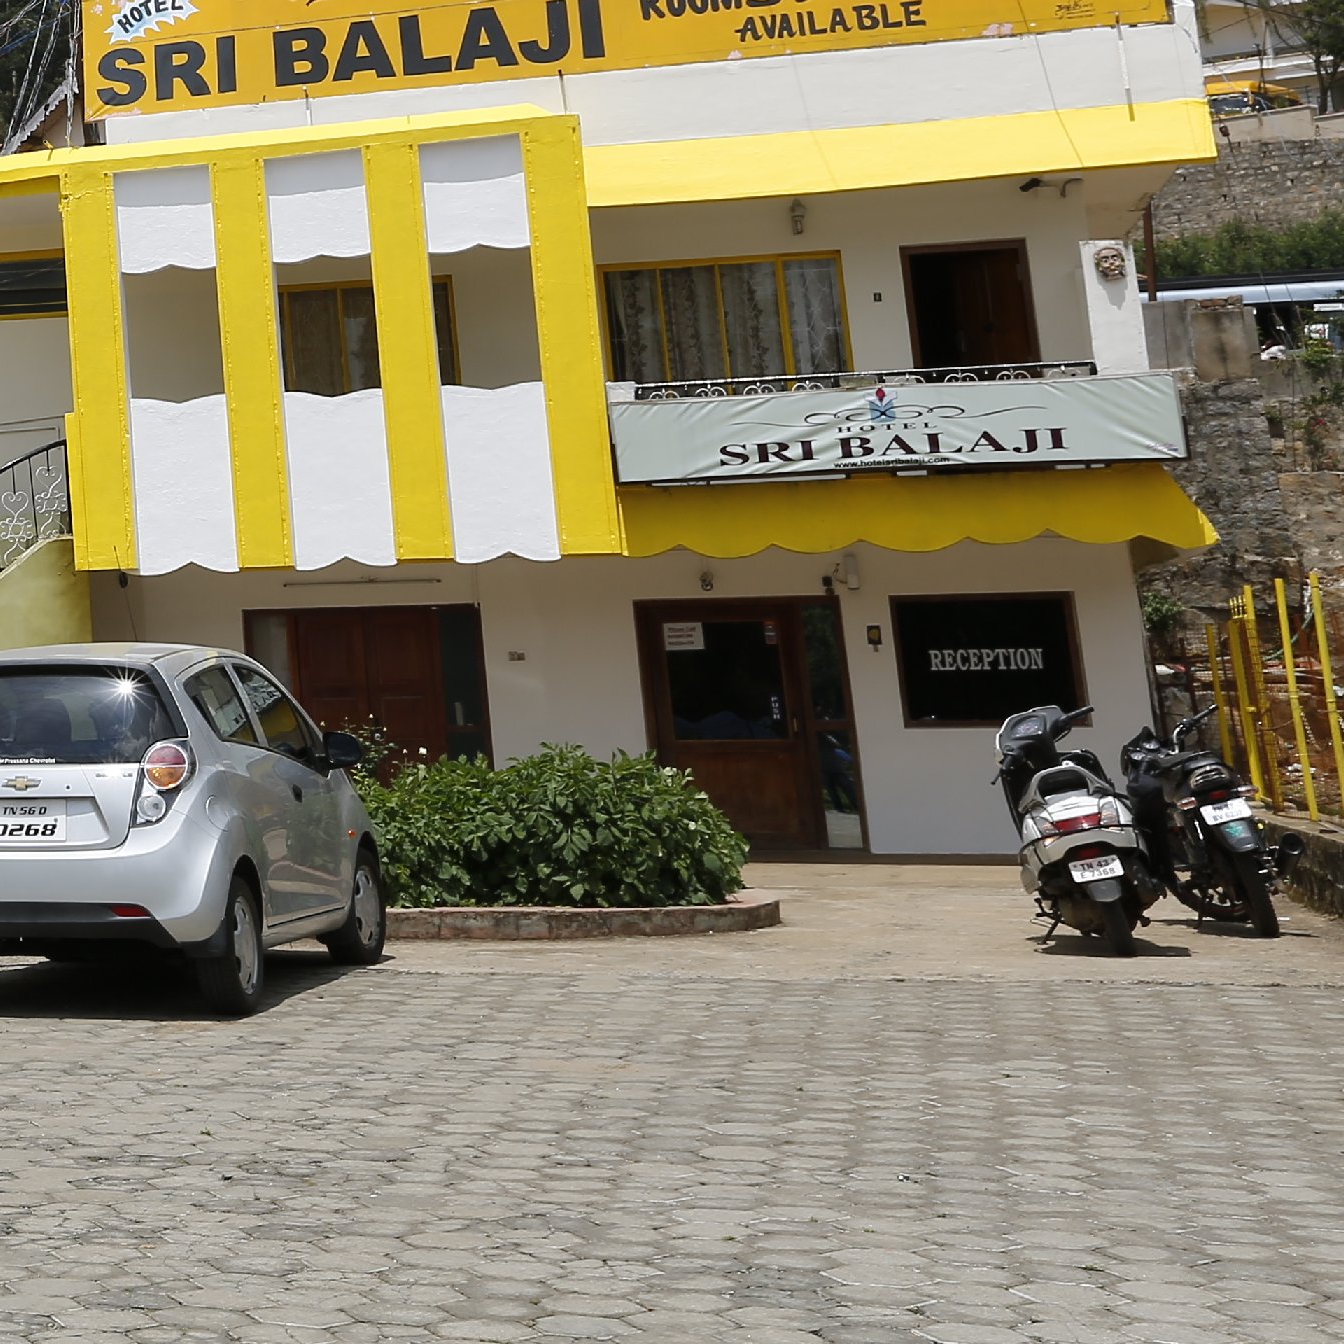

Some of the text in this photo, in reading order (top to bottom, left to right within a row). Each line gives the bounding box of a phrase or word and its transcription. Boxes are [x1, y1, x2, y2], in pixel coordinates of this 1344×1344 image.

[734, 0, 927, 43] AVAILABLE
[96, 34, 237, 107] SRI
[836, 422, 938, 433] HOTEL
[718, 426, 1069, 468] SRI BALAJI
[833, 456, 951, 469] www.hotelsribalaji.com
[927, 648, 1044, 672] RECEPTION
[2, 806, 18, 816] TN
[19, 806, 36, 816] 56
[1079, 859, 1110, 871] TN 43
